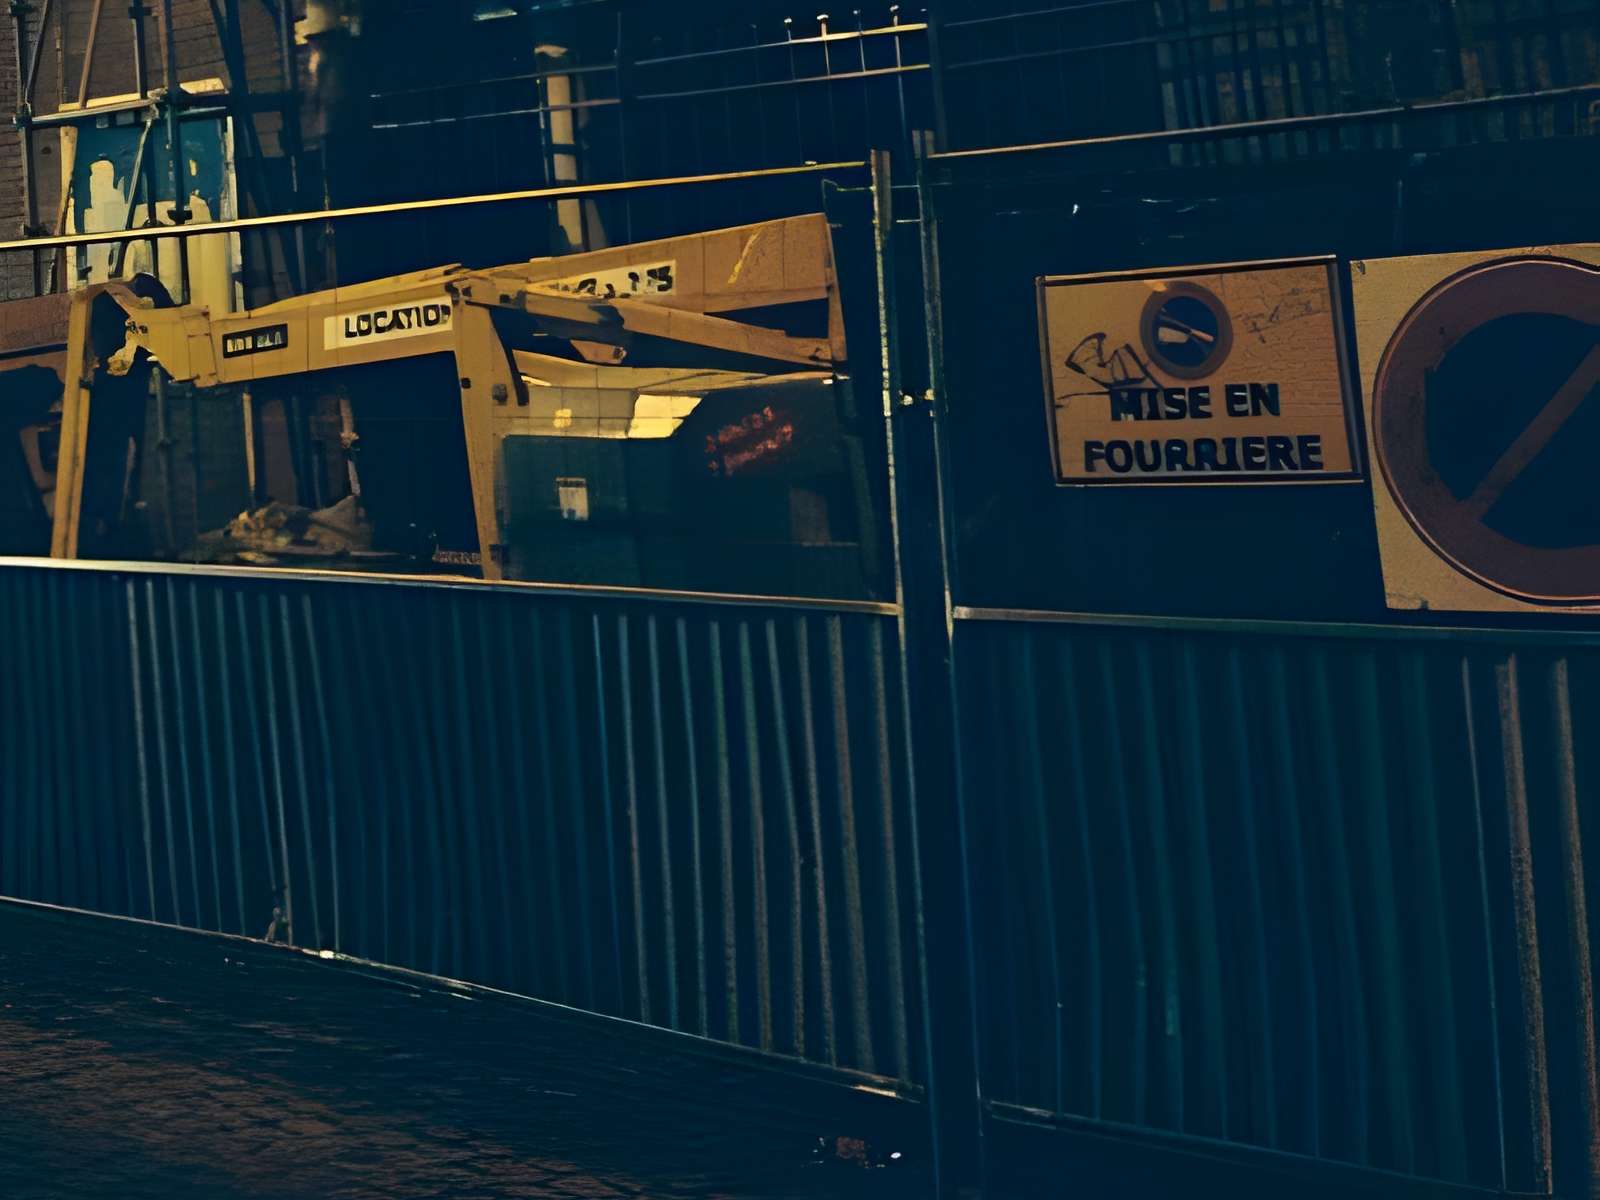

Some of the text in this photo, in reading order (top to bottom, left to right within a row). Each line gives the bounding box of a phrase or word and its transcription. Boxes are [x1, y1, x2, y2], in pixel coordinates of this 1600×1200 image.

[1110, 383, 1280, 421] MISE EN
[1084, 435, 1324, 473] FOURRIERE
